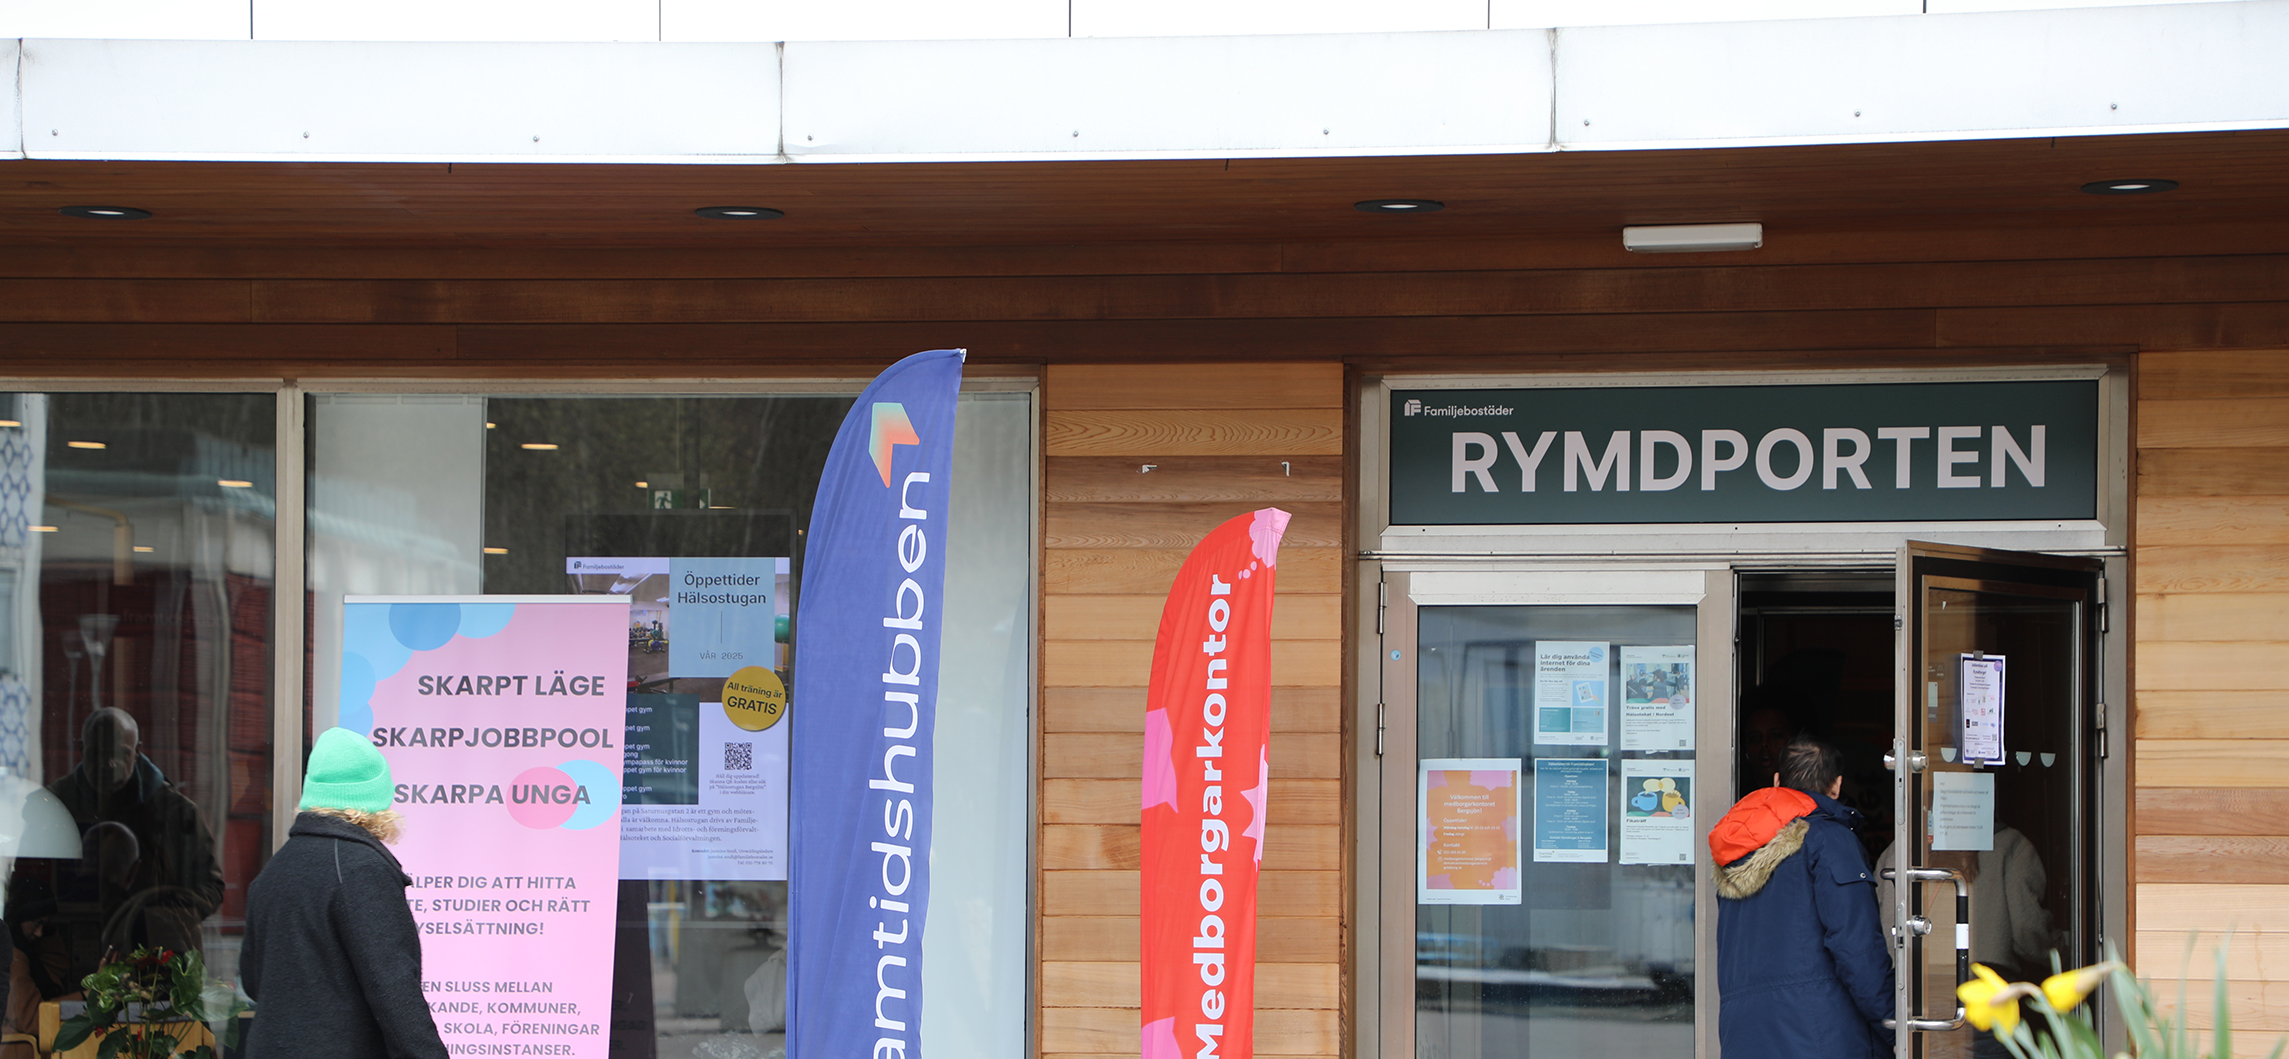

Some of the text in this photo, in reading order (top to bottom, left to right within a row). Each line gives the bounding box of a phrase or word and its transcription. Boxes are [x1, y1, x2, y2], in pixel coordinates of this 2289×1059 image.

[1424, 405, 1514, 418] Familjebostäder
[1451, 425, 2047, 493] RYMDPORTEN
[684, 570, 760, 588] Öppettider
[677, 591, 767, 607] Hälsostugan
[699, 650, 743, 660] VÅR 2025
[418, 670, 605, 696] SKARPT LÄGE
[727, 681, 783, 698] All träning är
[727, 696, 777, 715] GRATIS
[372, 727, 614, 748] SKARPJOBBPOOL
[394, 783, 591, 805] SKARPA UNGA
[671, 816, 708, 824] Hälsostugan
[1193, 574, 1231, 1059] Medborgarkontor
[458, 876, 487, 889] DIG
[491, 876, 523, 889] ATT
[527, 877, 576, 889] HITTA
[432, 899, 501, 912] STUDIER
[505, 899, 543, 912] OCH
[547, 897, 590, 912] RÄTT
[422, 981, 553, 993] EN SLUSS MELLAN
[487, 1002, 581, 1015] KOMMUNER,
[444, 1022, 498, 1036] SKOLA,
[502, 1020, 600, 1035] FÖRENINGAR
[445, 1043, 576, 1056] INGSINSTANSER.
